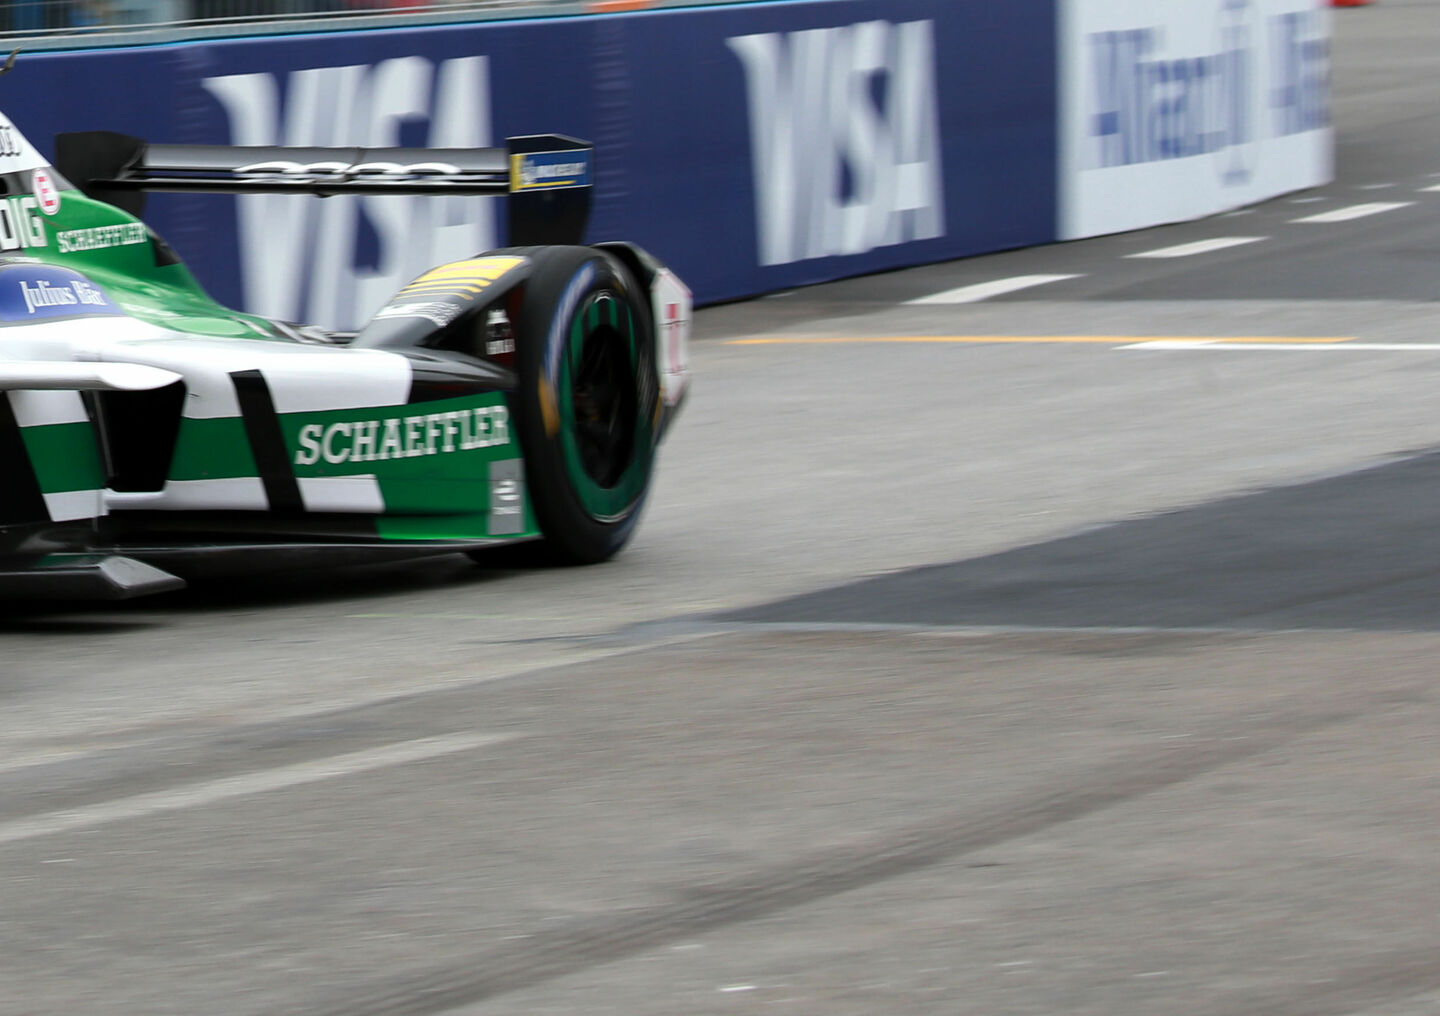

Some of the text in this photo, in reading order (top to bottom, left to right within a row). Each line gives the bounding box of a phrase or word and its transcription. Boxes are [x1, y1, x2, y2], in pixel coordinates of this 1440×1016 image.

[202, 55, 497, 333] VISA
[726, 19, 946, 266] VISA
[18, 280, 78, 314] Julius
[294, 405, 510, 465] SCHAEFFLER
